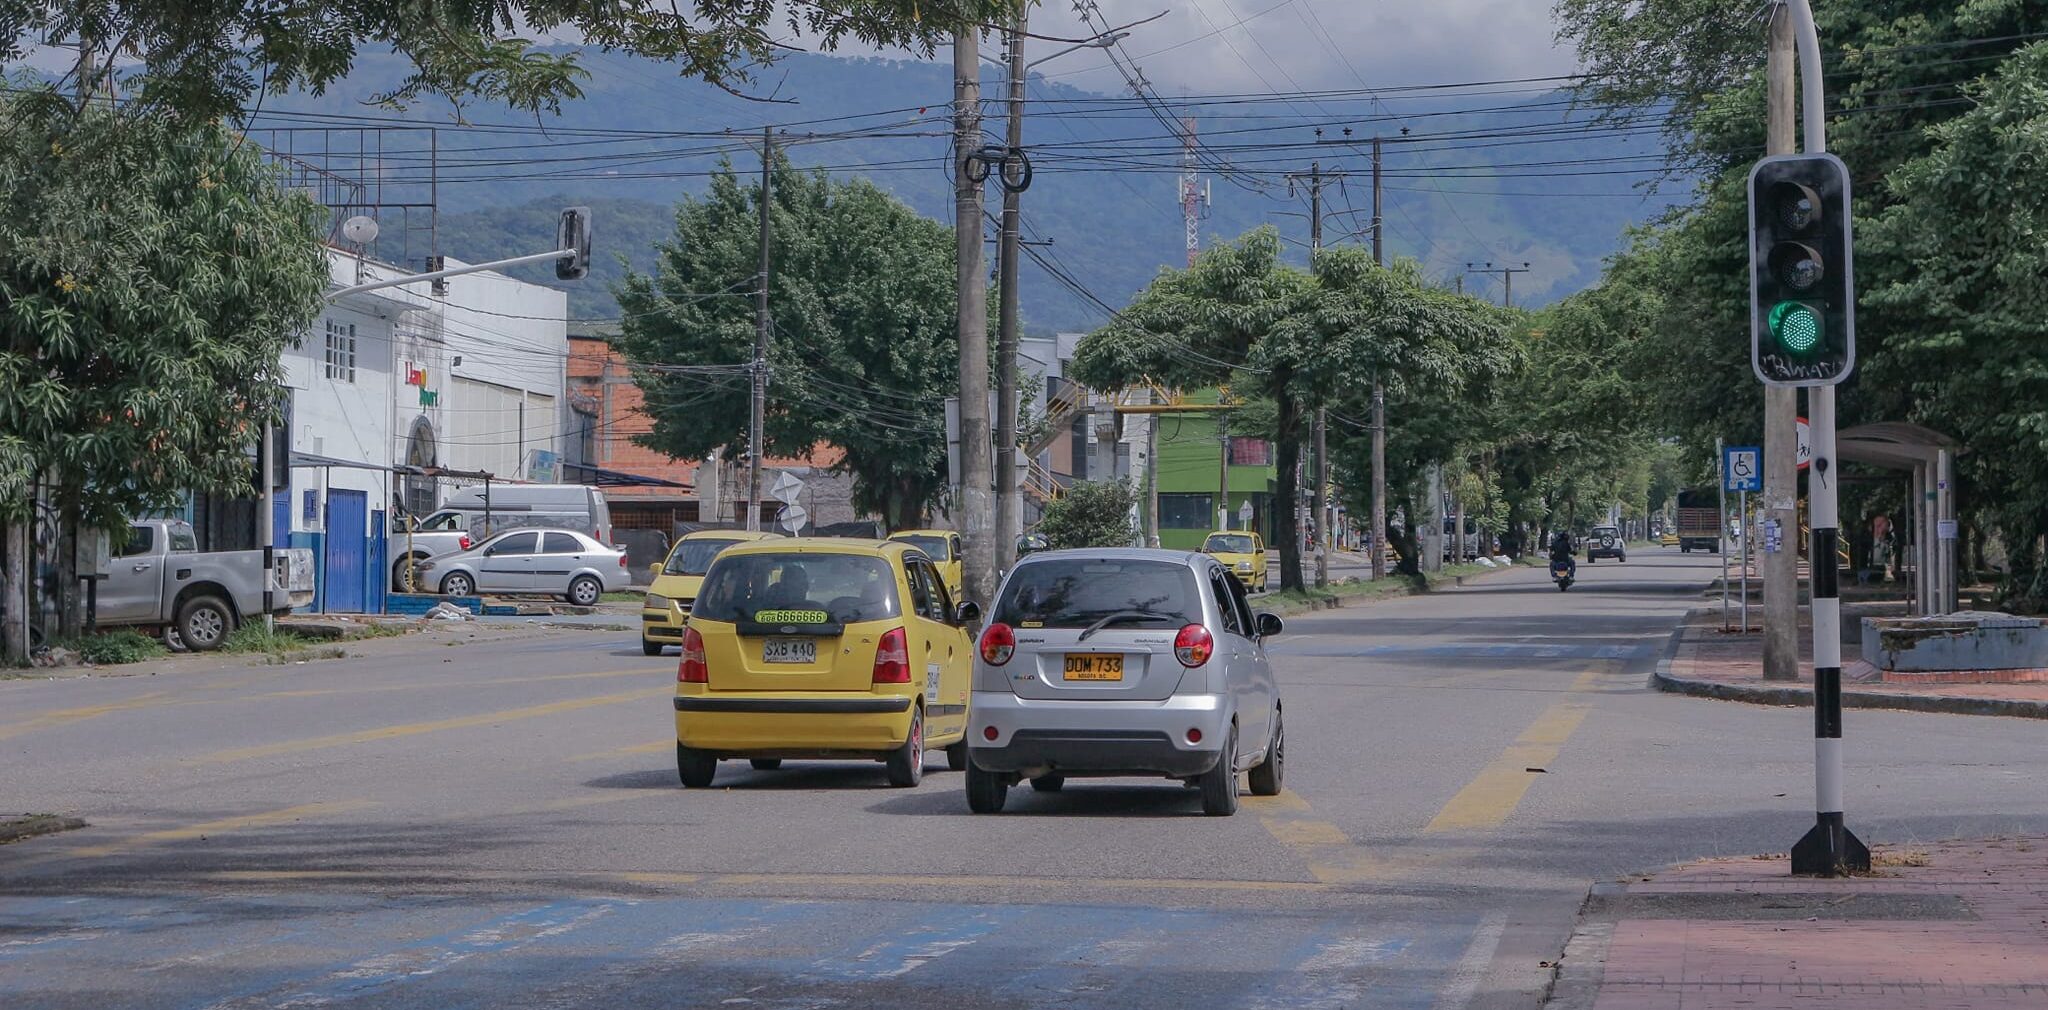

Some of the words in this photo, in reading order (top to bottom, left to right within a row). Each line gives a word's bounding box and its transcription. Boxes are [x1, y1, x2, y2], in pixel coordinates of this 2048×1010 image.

[776, 611, 823, 622] 6666666
[766, 641, 788, 656] SXB
[791, 642, 815, 656] 440
[1066, 656, 1092, 673] DOM
[1095, 656, 1121, 673] 733
